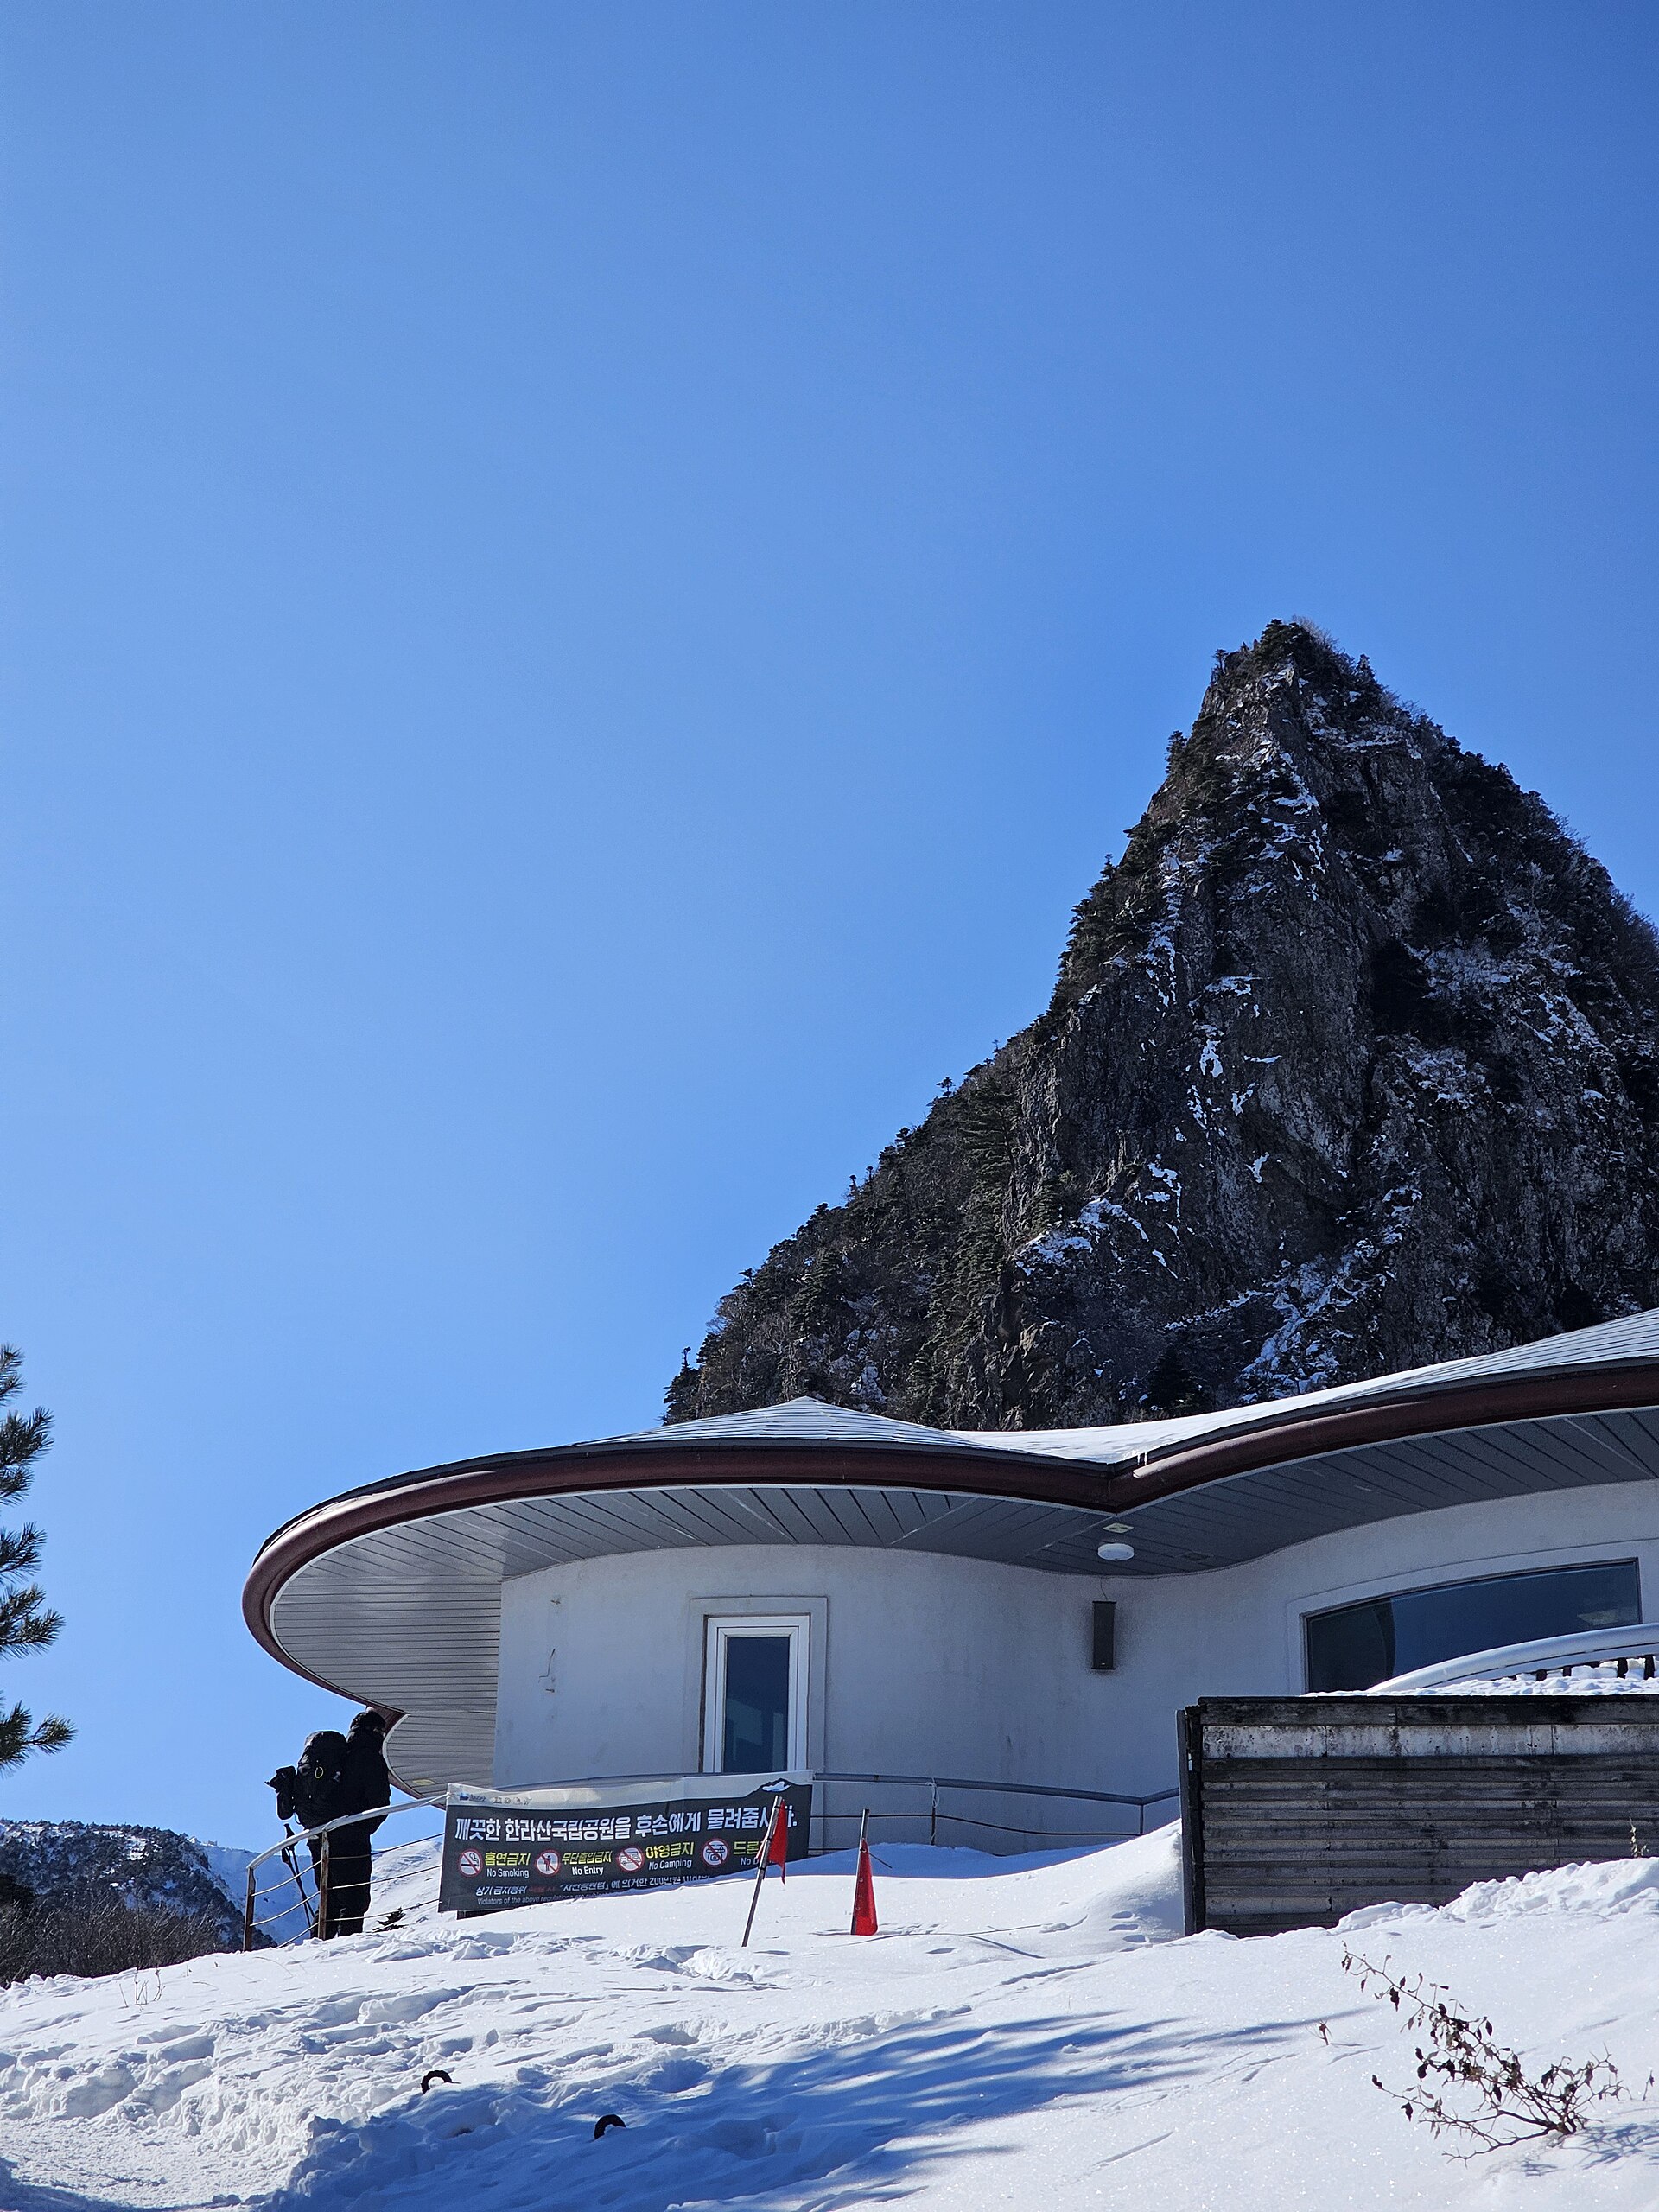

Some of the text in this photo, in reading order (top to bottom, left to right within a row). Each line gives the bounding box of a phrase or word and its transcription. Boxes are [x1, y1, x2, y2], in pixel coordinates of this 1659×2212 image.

[455, 1818, 501, 1841] 깨끗한
[505, 1816, 632, 1842] 한라산국립공원을
[635, 1812, 702, 1838] 후손에게
[645, 1841, 695, 1859] 야영금지
[485, 1852, 531, 1866] 흡연금지
[561, 1850, 613, 1866] 무단출입금지
[649, 1858, 693, 1871] No Camping
[741, 1857, 752, 1866] No
[486, 1867, 530, 1878] No Smoking
[572, 1866, 604, 1876] No Entry
[478, 1896, 503, 1905] Violators
